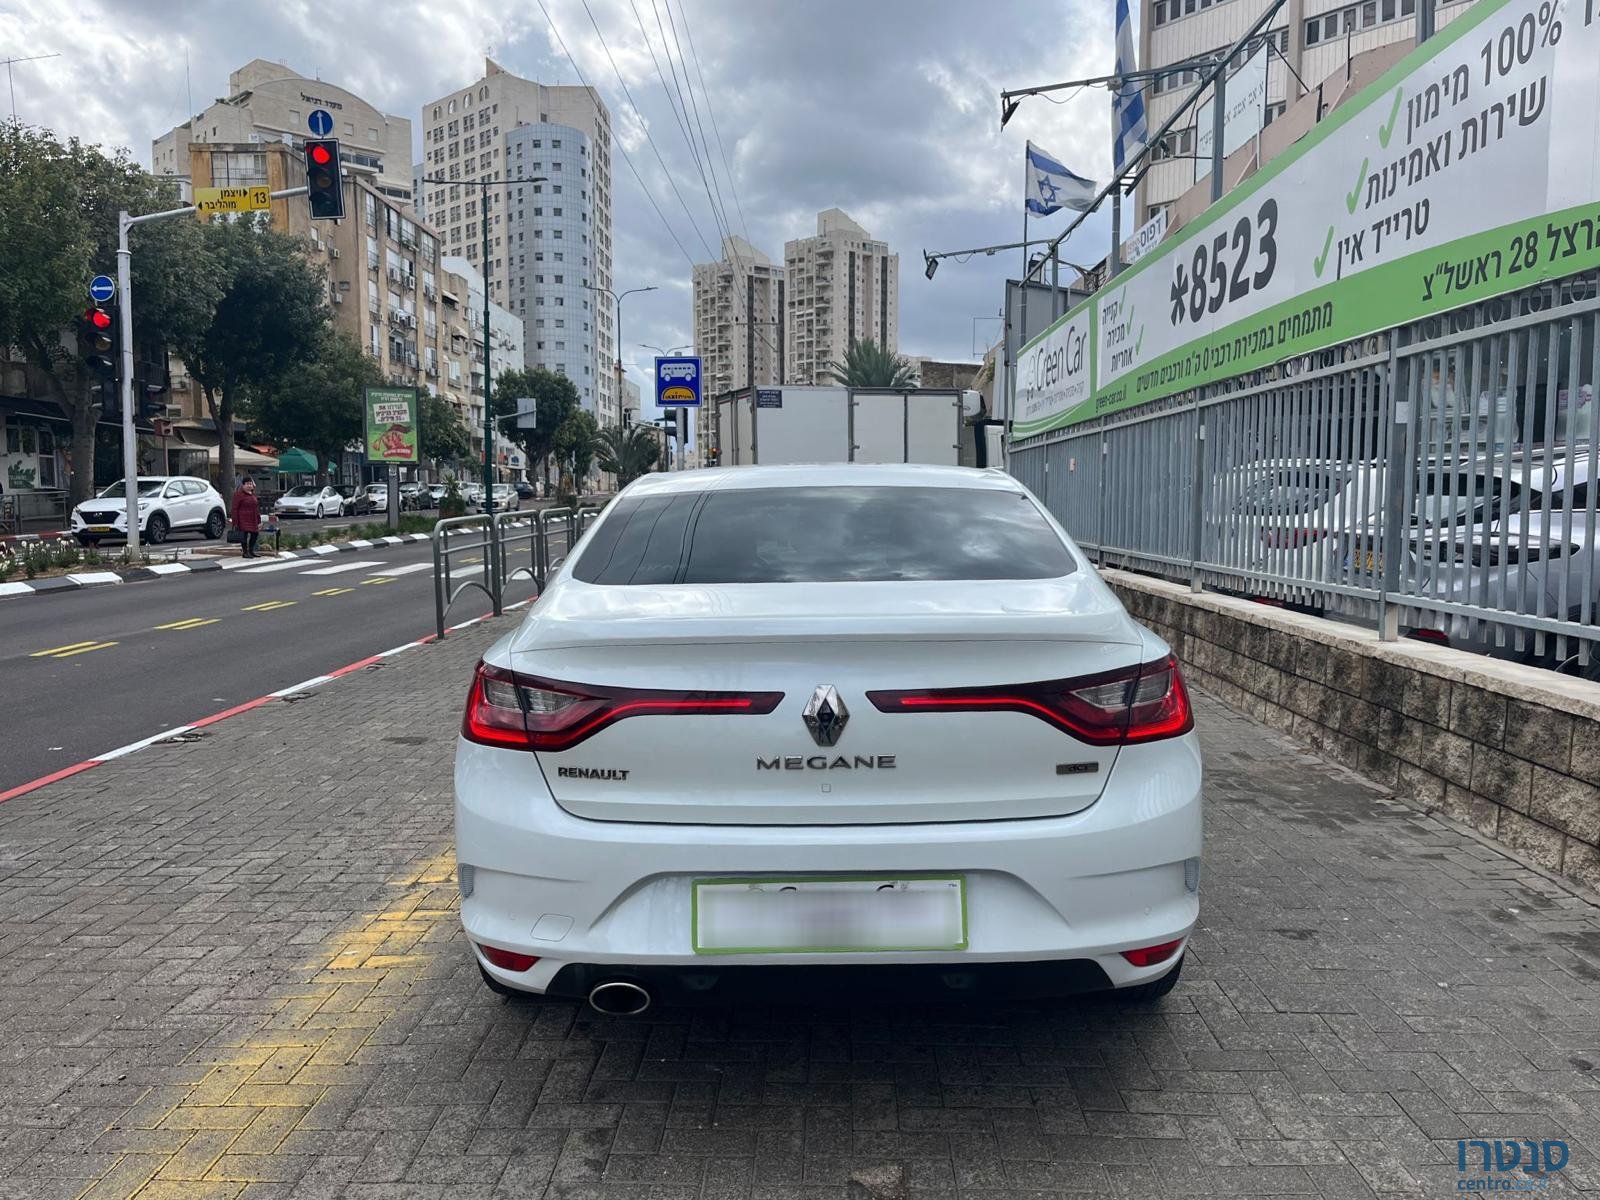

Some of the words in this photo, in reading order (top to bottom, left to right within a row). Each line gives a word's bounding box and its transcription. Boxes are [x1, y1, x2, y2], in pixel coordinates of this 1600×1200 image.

[1481, 0, 1562, 87] 100%
[1406, 64, 1469, 145] מימון
[1458, 75, 1547, 160] שירות
[1365, 130, 1451, 210] ואמינות
[205, 198, 237, 209] מוהליבר
[220, 188, 242, 200] ויצמן
[254, 192, 267, 204] 13
[1140, 217, 1161, 248] דפוס
[1372, 198, 1430, 254] טרייד
[1337, 229, 1365, 281] אין
[1508, 230, 1539, 274] 28
[1422, 250, 1502, 301] ראשל"צ
[1102, 301, 1118, 325] קנייה
[1278, 301, 1333, 344] מתמחים
[1107, 324, 1125, 348] מכירה
[1233, 325, 1274, 360] במכירת
[1036, 346, 1063, 391] Green
[1066, 325, 1087, 376] Car
[1111, 347, 1133, 372] אחריות
[1203, 347, 1209, 371] 0
[1211, 342, 1231, 367] רכבי
[1136, 369, 1159, 393] חדשים
[1160, 360, 1184, 385] ורכבים
[557, 766, 630, 781] RENAULT
[756, 753, 897, 771] MEGANE
